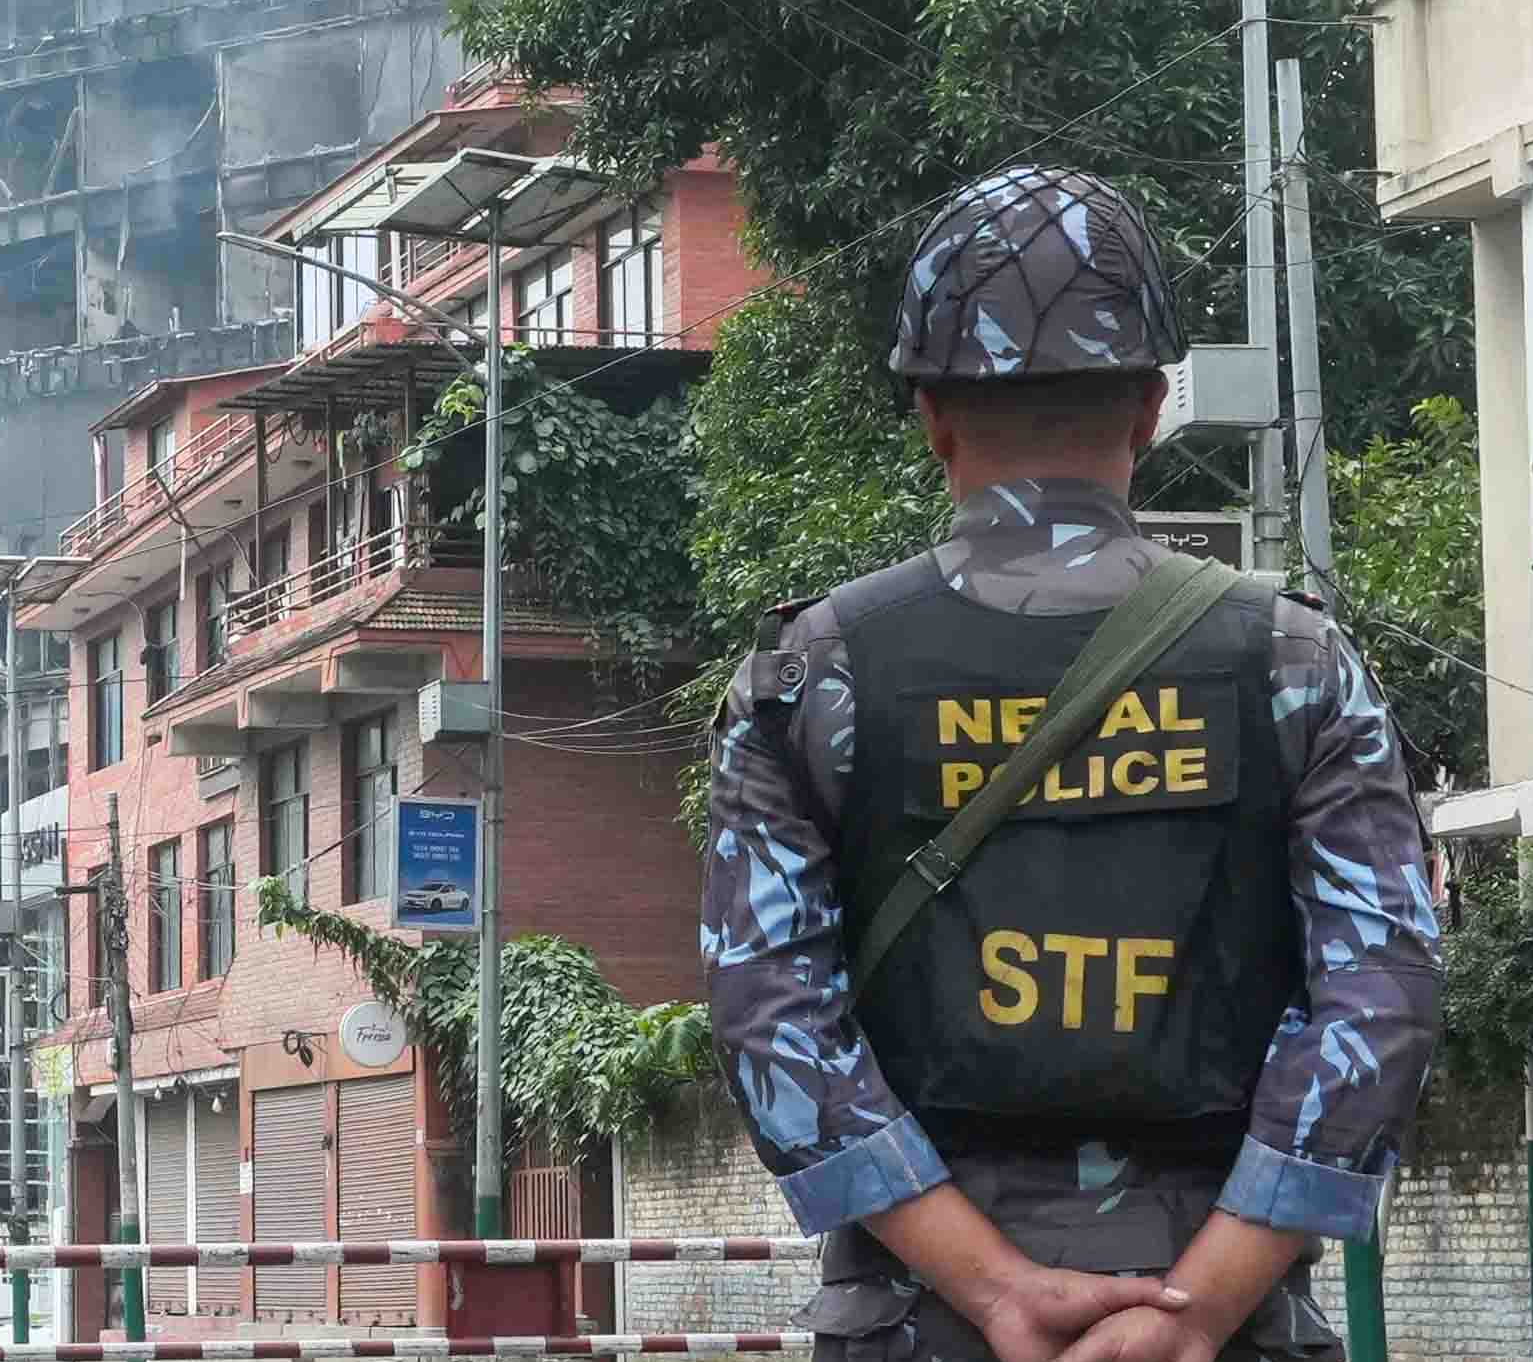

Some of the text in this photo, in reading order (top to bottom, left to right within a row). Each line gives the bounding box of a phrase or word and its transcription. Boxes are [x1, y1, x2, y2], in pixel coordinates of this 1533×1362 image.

[1151, 533, 1209, 547] BYD
[936, 686, 1205, 745] NEAL
[979, 929, 1176, 1032] STF
